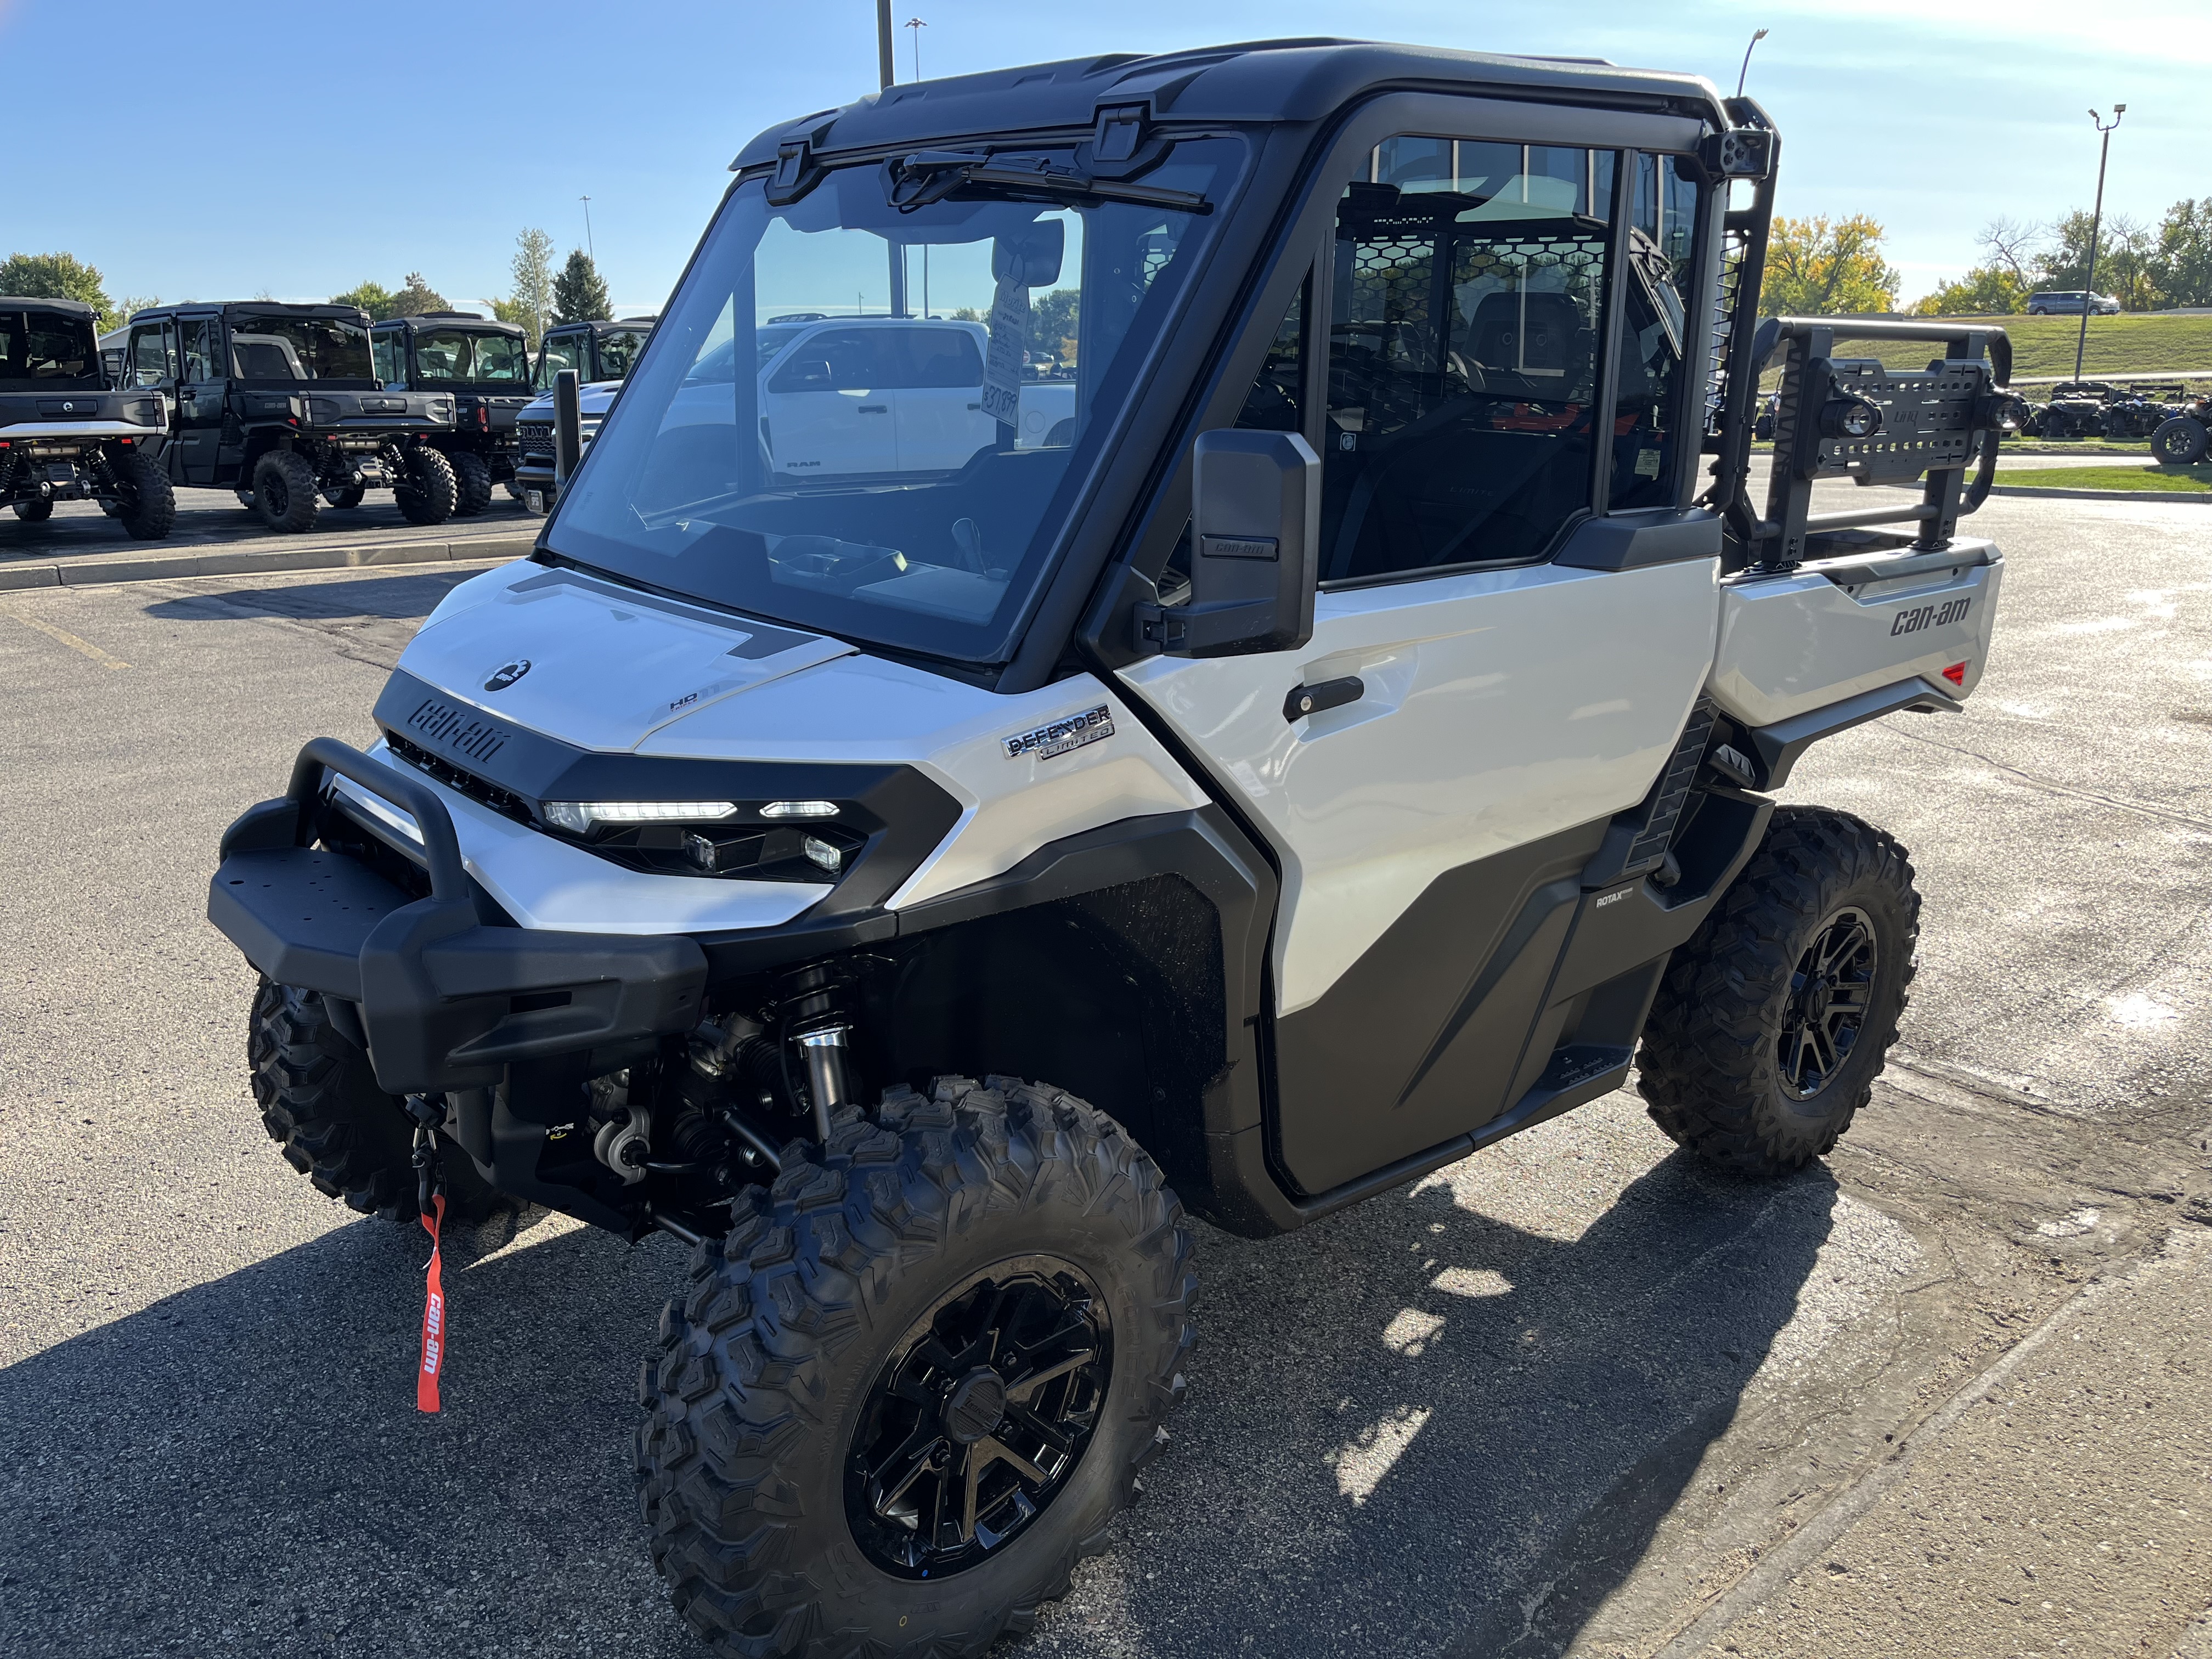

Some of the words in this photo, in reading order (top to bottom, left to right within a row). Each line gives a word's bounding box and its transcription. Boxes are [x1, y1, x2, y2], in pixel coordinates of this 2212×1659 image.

[1000, 290, 1026, 313] Moritz
[1216, 543, 1265, 554] can-am
[1890, 597, 1971, 636] can-am
[407, 699, 512, 764] can-am
[1008, 704, 1110, 753] DEFENDER
[1046, 727, 1109, 755] LIMITED
[1596, 890, 1622, 908] ROTAX
[424, 1293, 441, 1374] can-am
